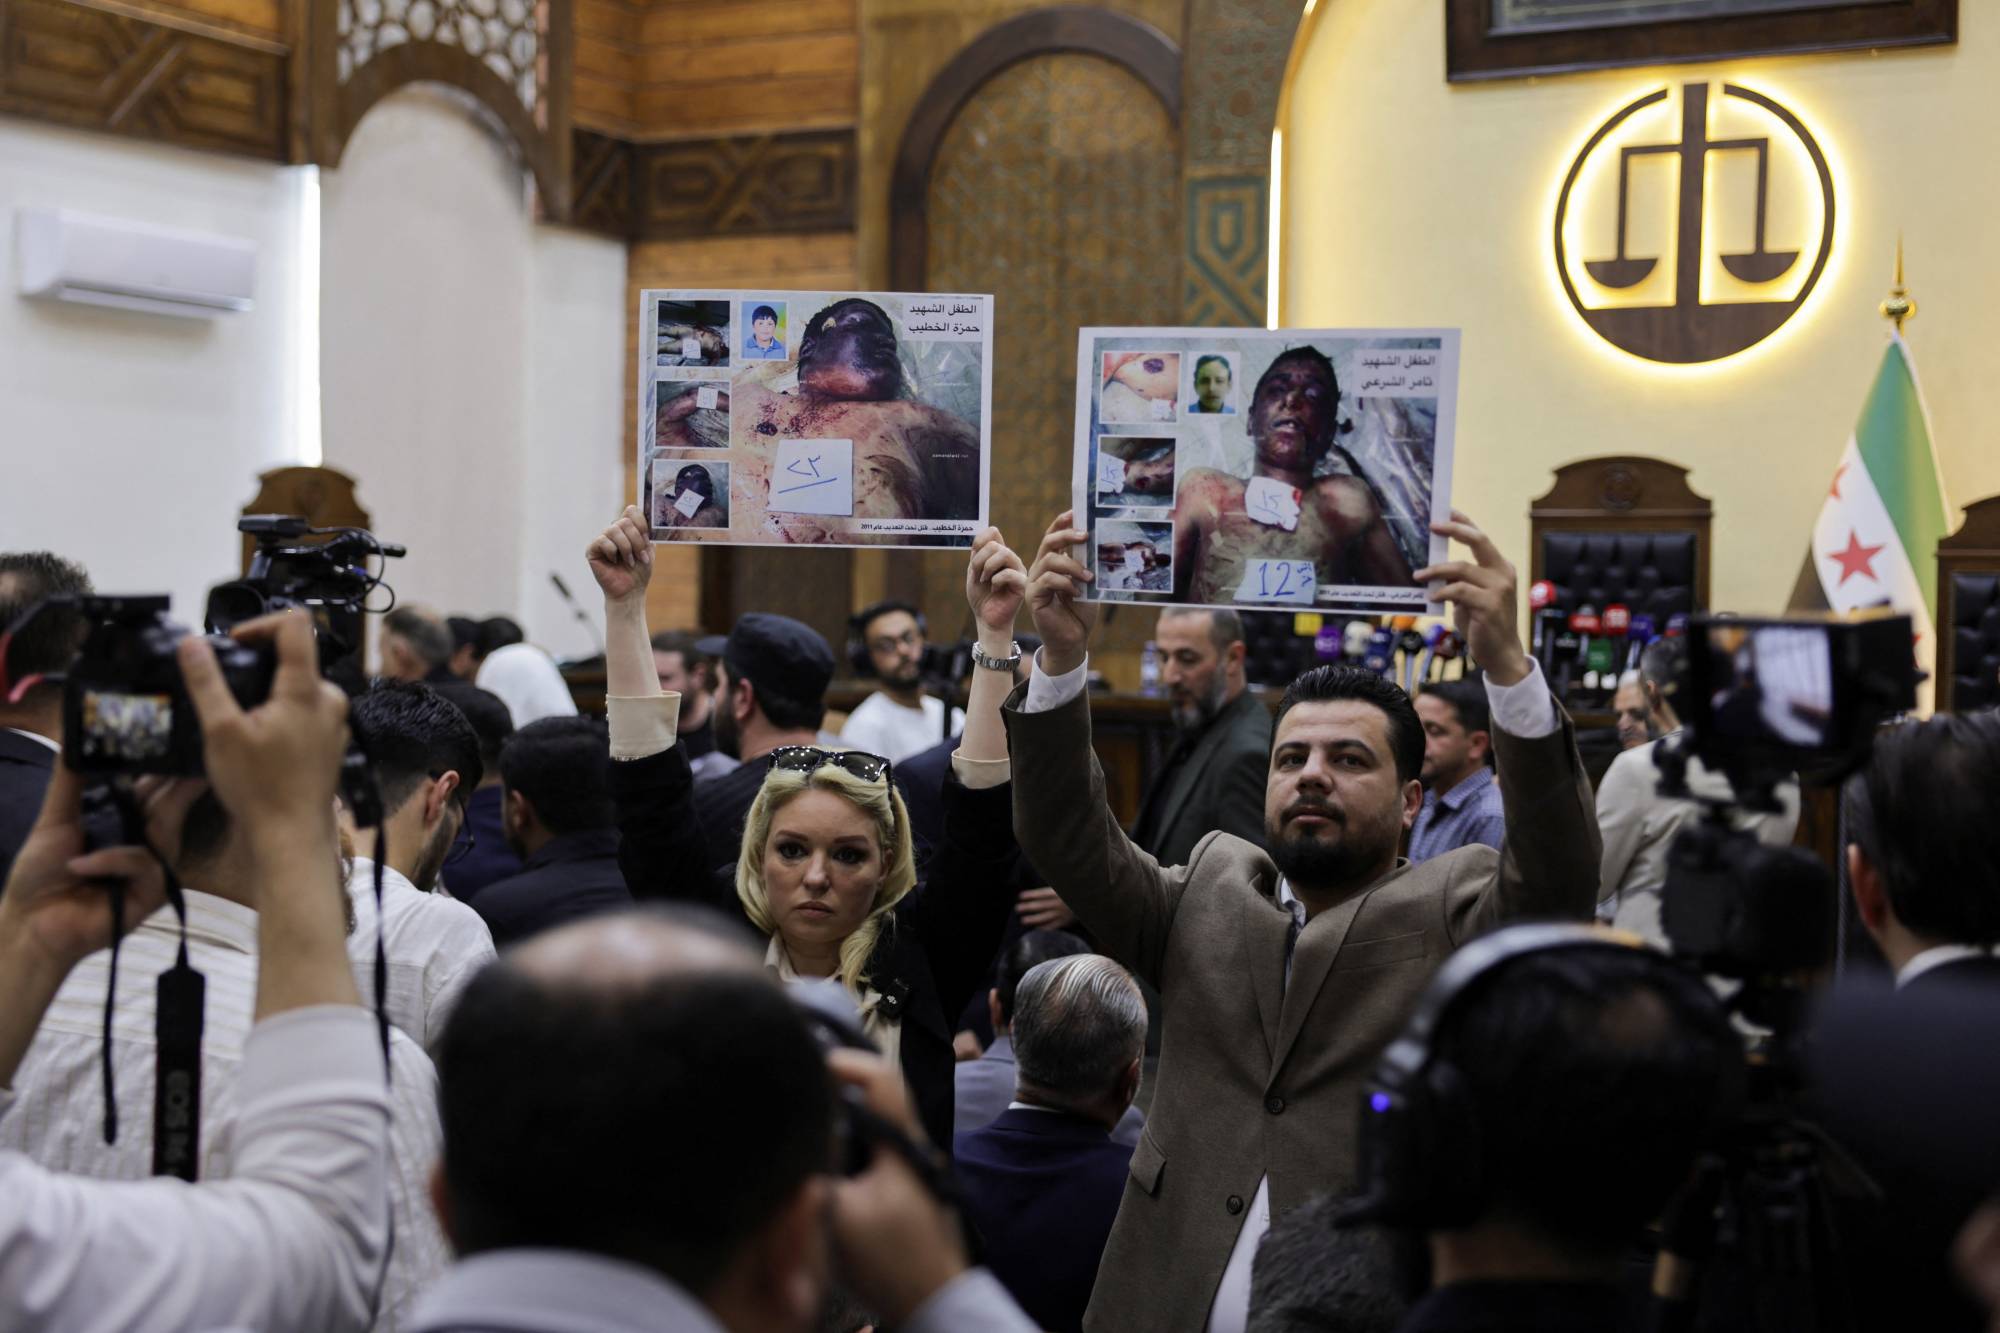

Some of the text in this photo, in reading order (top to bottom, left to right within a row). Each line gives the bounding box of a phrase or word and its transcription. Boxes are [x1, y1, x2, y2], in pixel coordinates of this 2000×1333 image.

[910, 304, 976, 316] الطفل الشهيد
[909, 322, 980, 335] حمزة الخطيب
[1361, 354, 1435, 369] الطفل الشهيد
[1361, 376, 1405, 390] الشرعي
[931, 523, 956, 533] الخطيب
[957, 524, 974, 533] حمزة
[1258, 561, 1295, 597] 12
